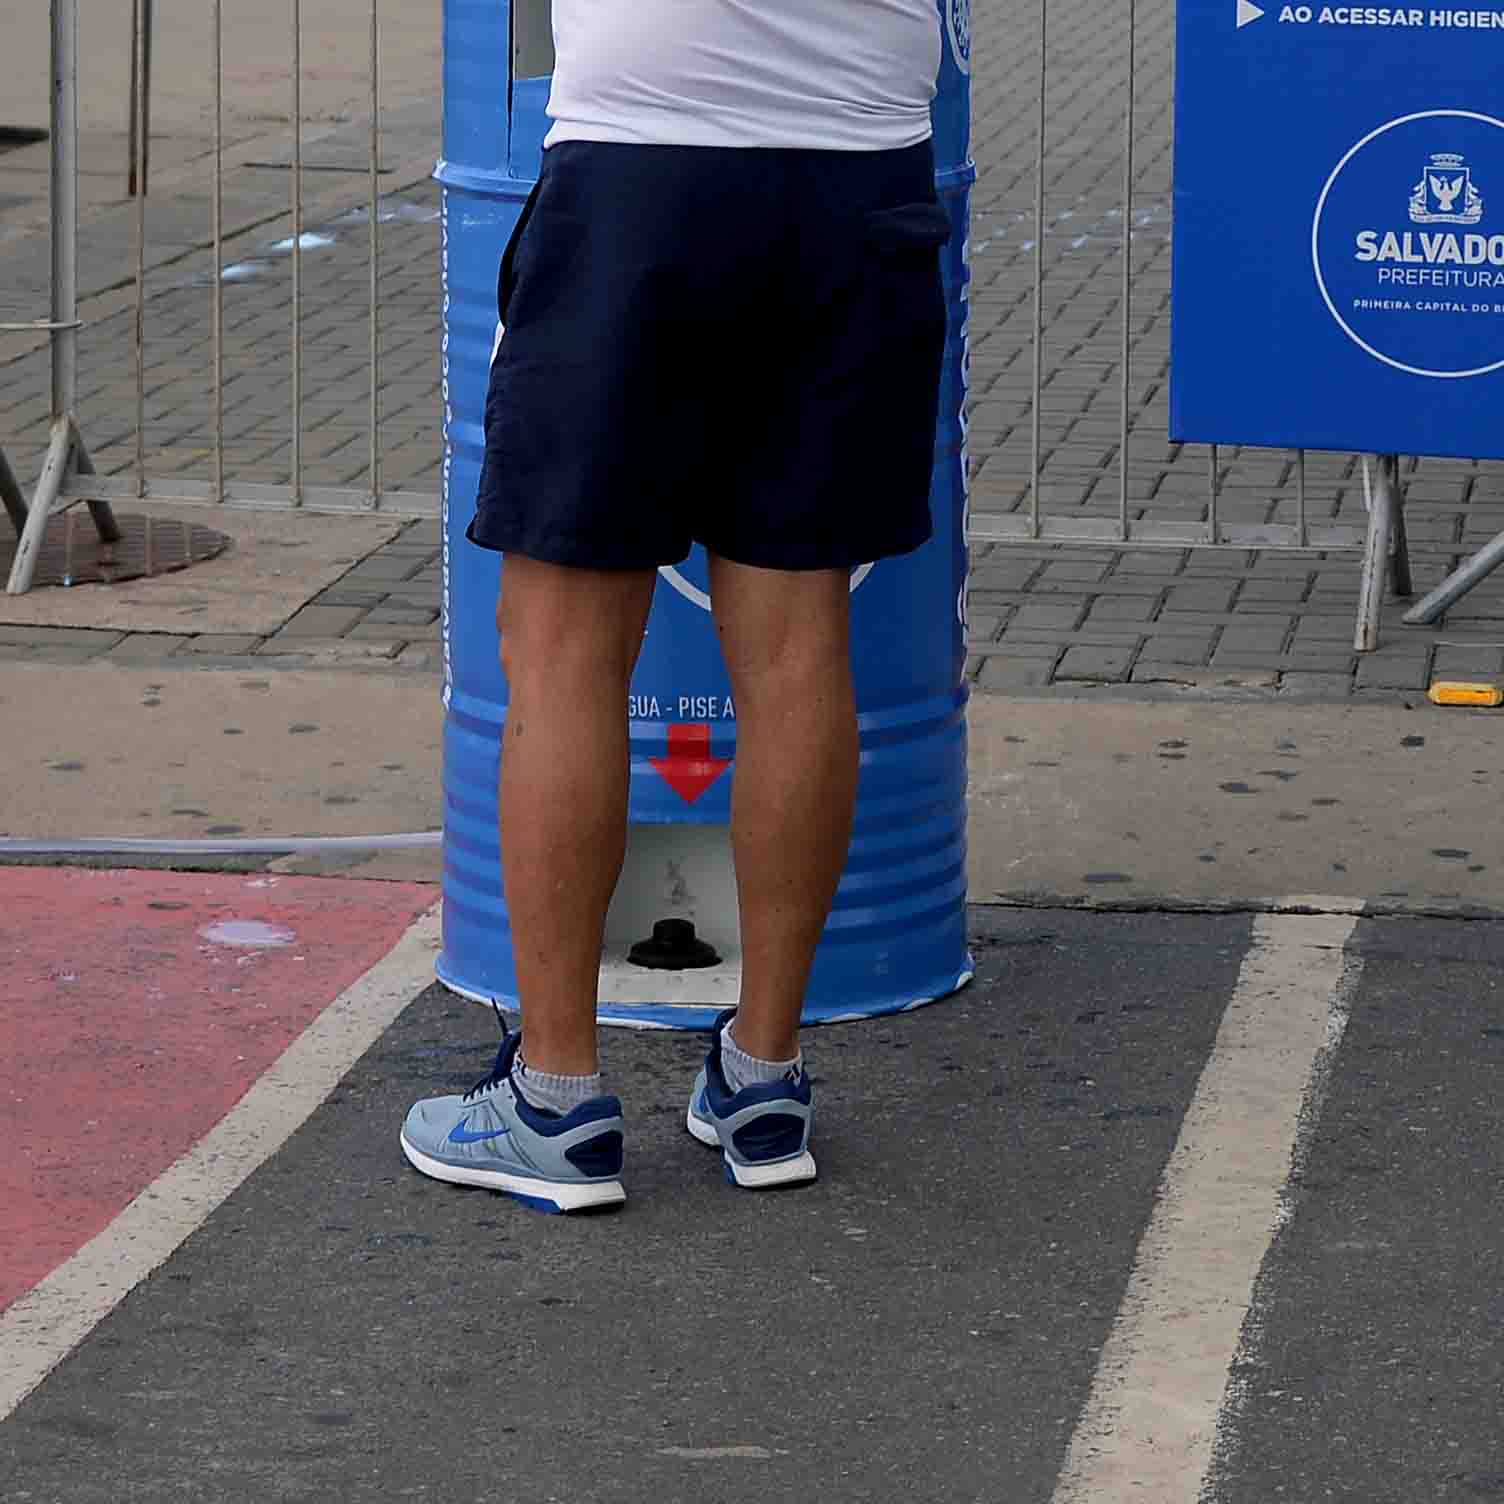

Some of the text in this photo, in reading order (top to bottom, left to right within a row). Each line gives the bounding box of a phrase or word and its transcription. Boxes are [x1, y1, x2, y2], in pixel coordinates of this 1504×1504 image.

[1278, 5, 1313, 23] AO
[1317, 6, 1424, 27] ACESSAR
[1353, 299, 1412, 310] PRIMEIRA
[1415, 301, 1468, 313] CAPITAL
[1471, 303, 1490, 313] DO
[679, 696, 717, 718] PISE
